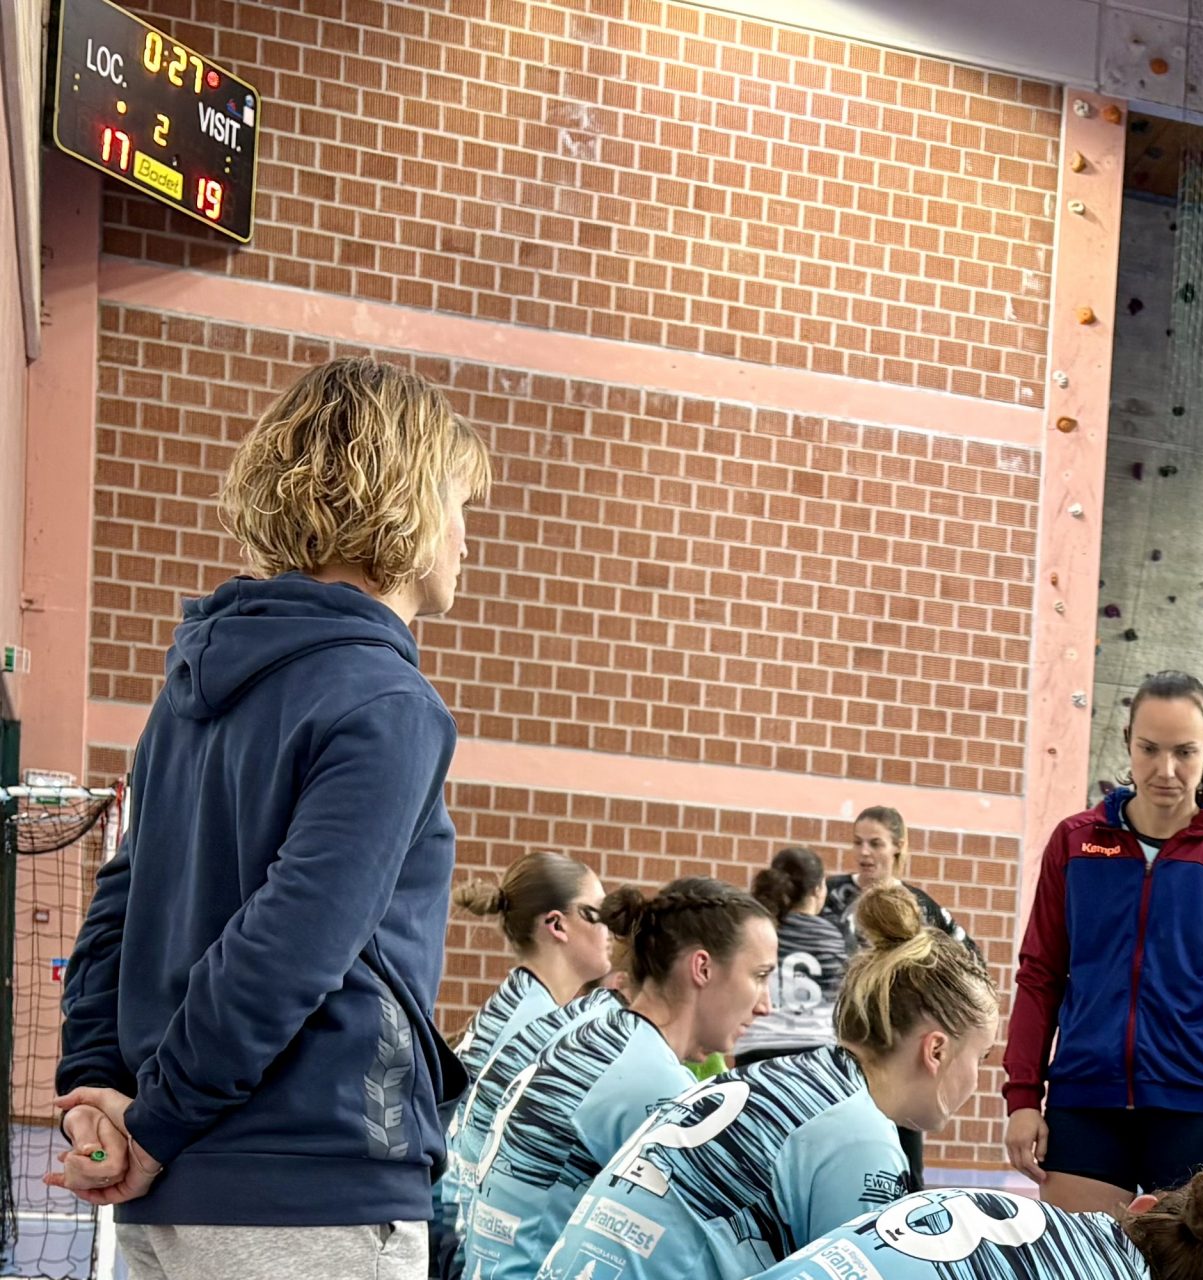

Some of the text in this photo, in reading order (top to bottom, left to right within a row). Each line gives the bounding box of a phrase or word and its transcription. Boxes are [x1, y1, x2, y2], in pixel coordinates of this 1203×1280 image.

[87, 39, 127, 88] LOC.
[143, 31, 203, 94] 0:27
[153, 113, 170, 147] 2
[198, 101, 242, 152] VISIT.
[102, 127, 130, 171] 17
[138, 158, 179, 194] Bodet
[196, 177, 223, 220] 19
